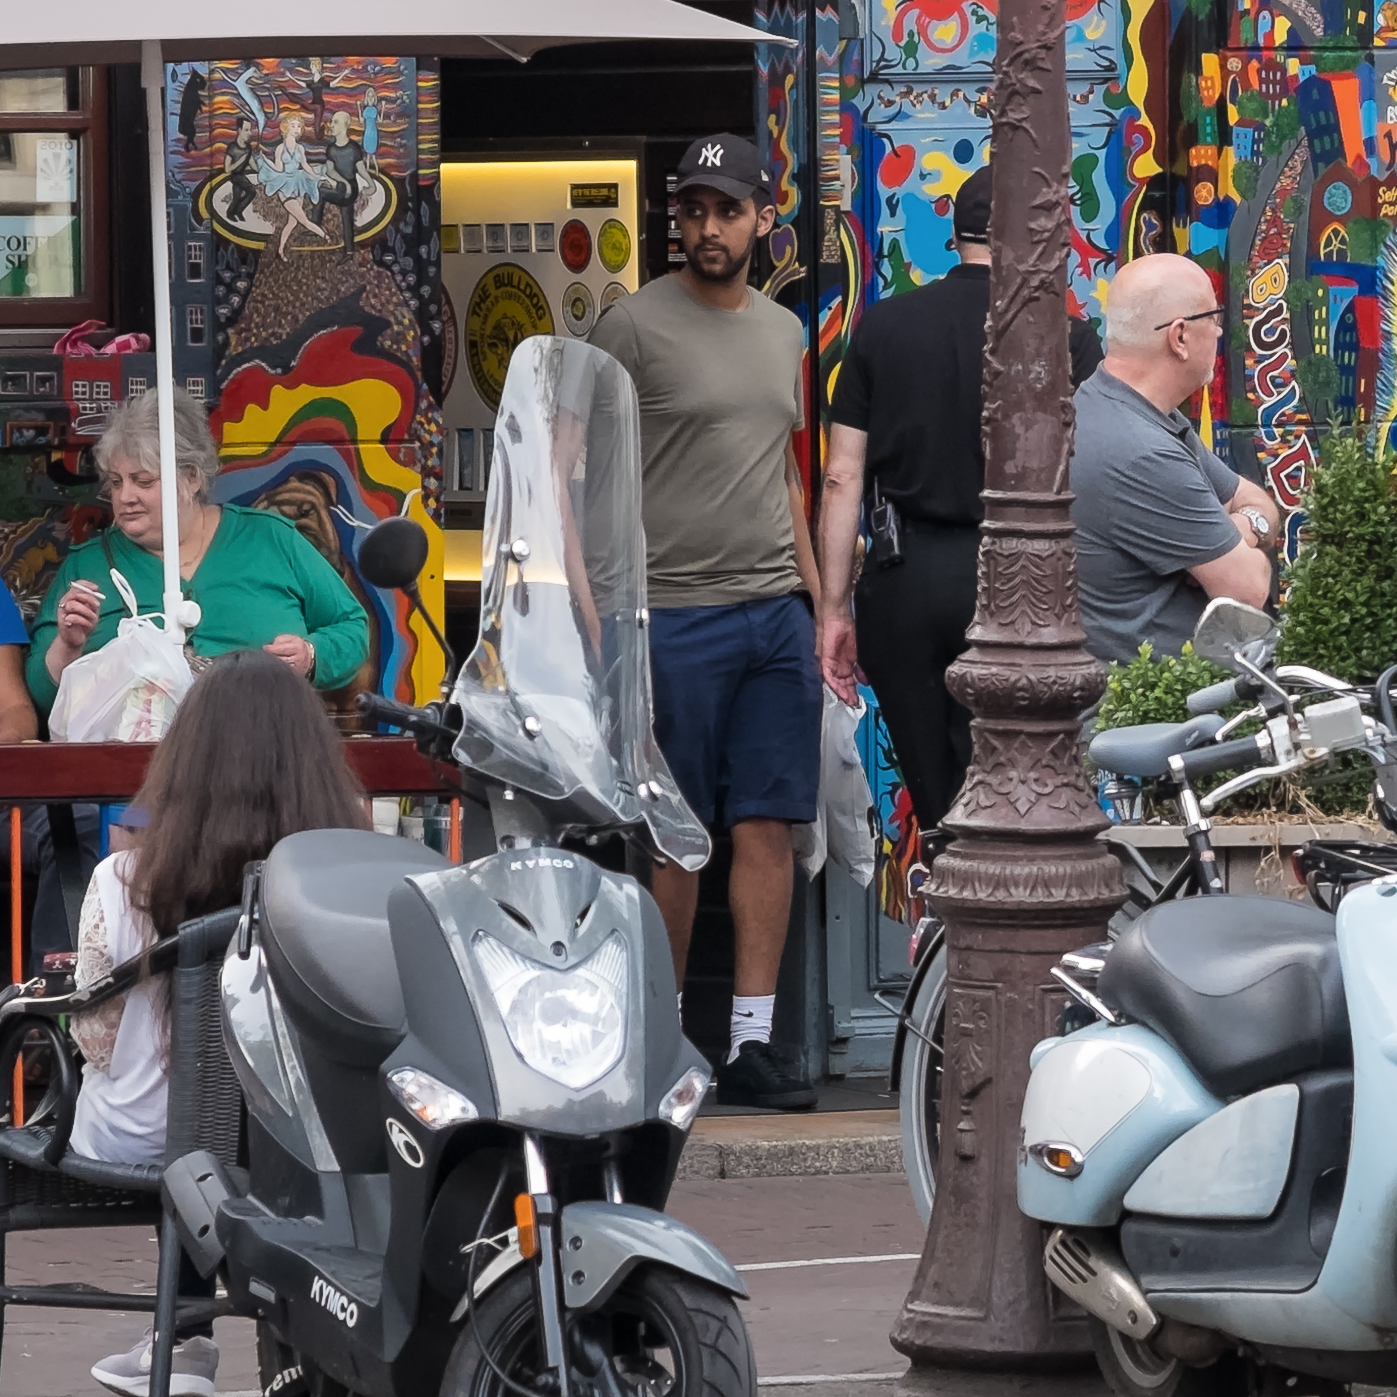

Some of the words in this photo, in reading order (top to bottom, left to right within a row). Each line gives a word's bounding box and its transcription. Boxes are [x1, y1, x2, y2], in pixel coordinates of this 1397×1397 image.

[40, 140, 74, 151] 2010
[697, 143, 725, 168] NY
[471, 284, 492, 321] THE
[493, 270, 547, 323] BULLDOG
[511, 857, 575, 872] KYMCO
[309, 1275, 359, 1329] KYMCO
